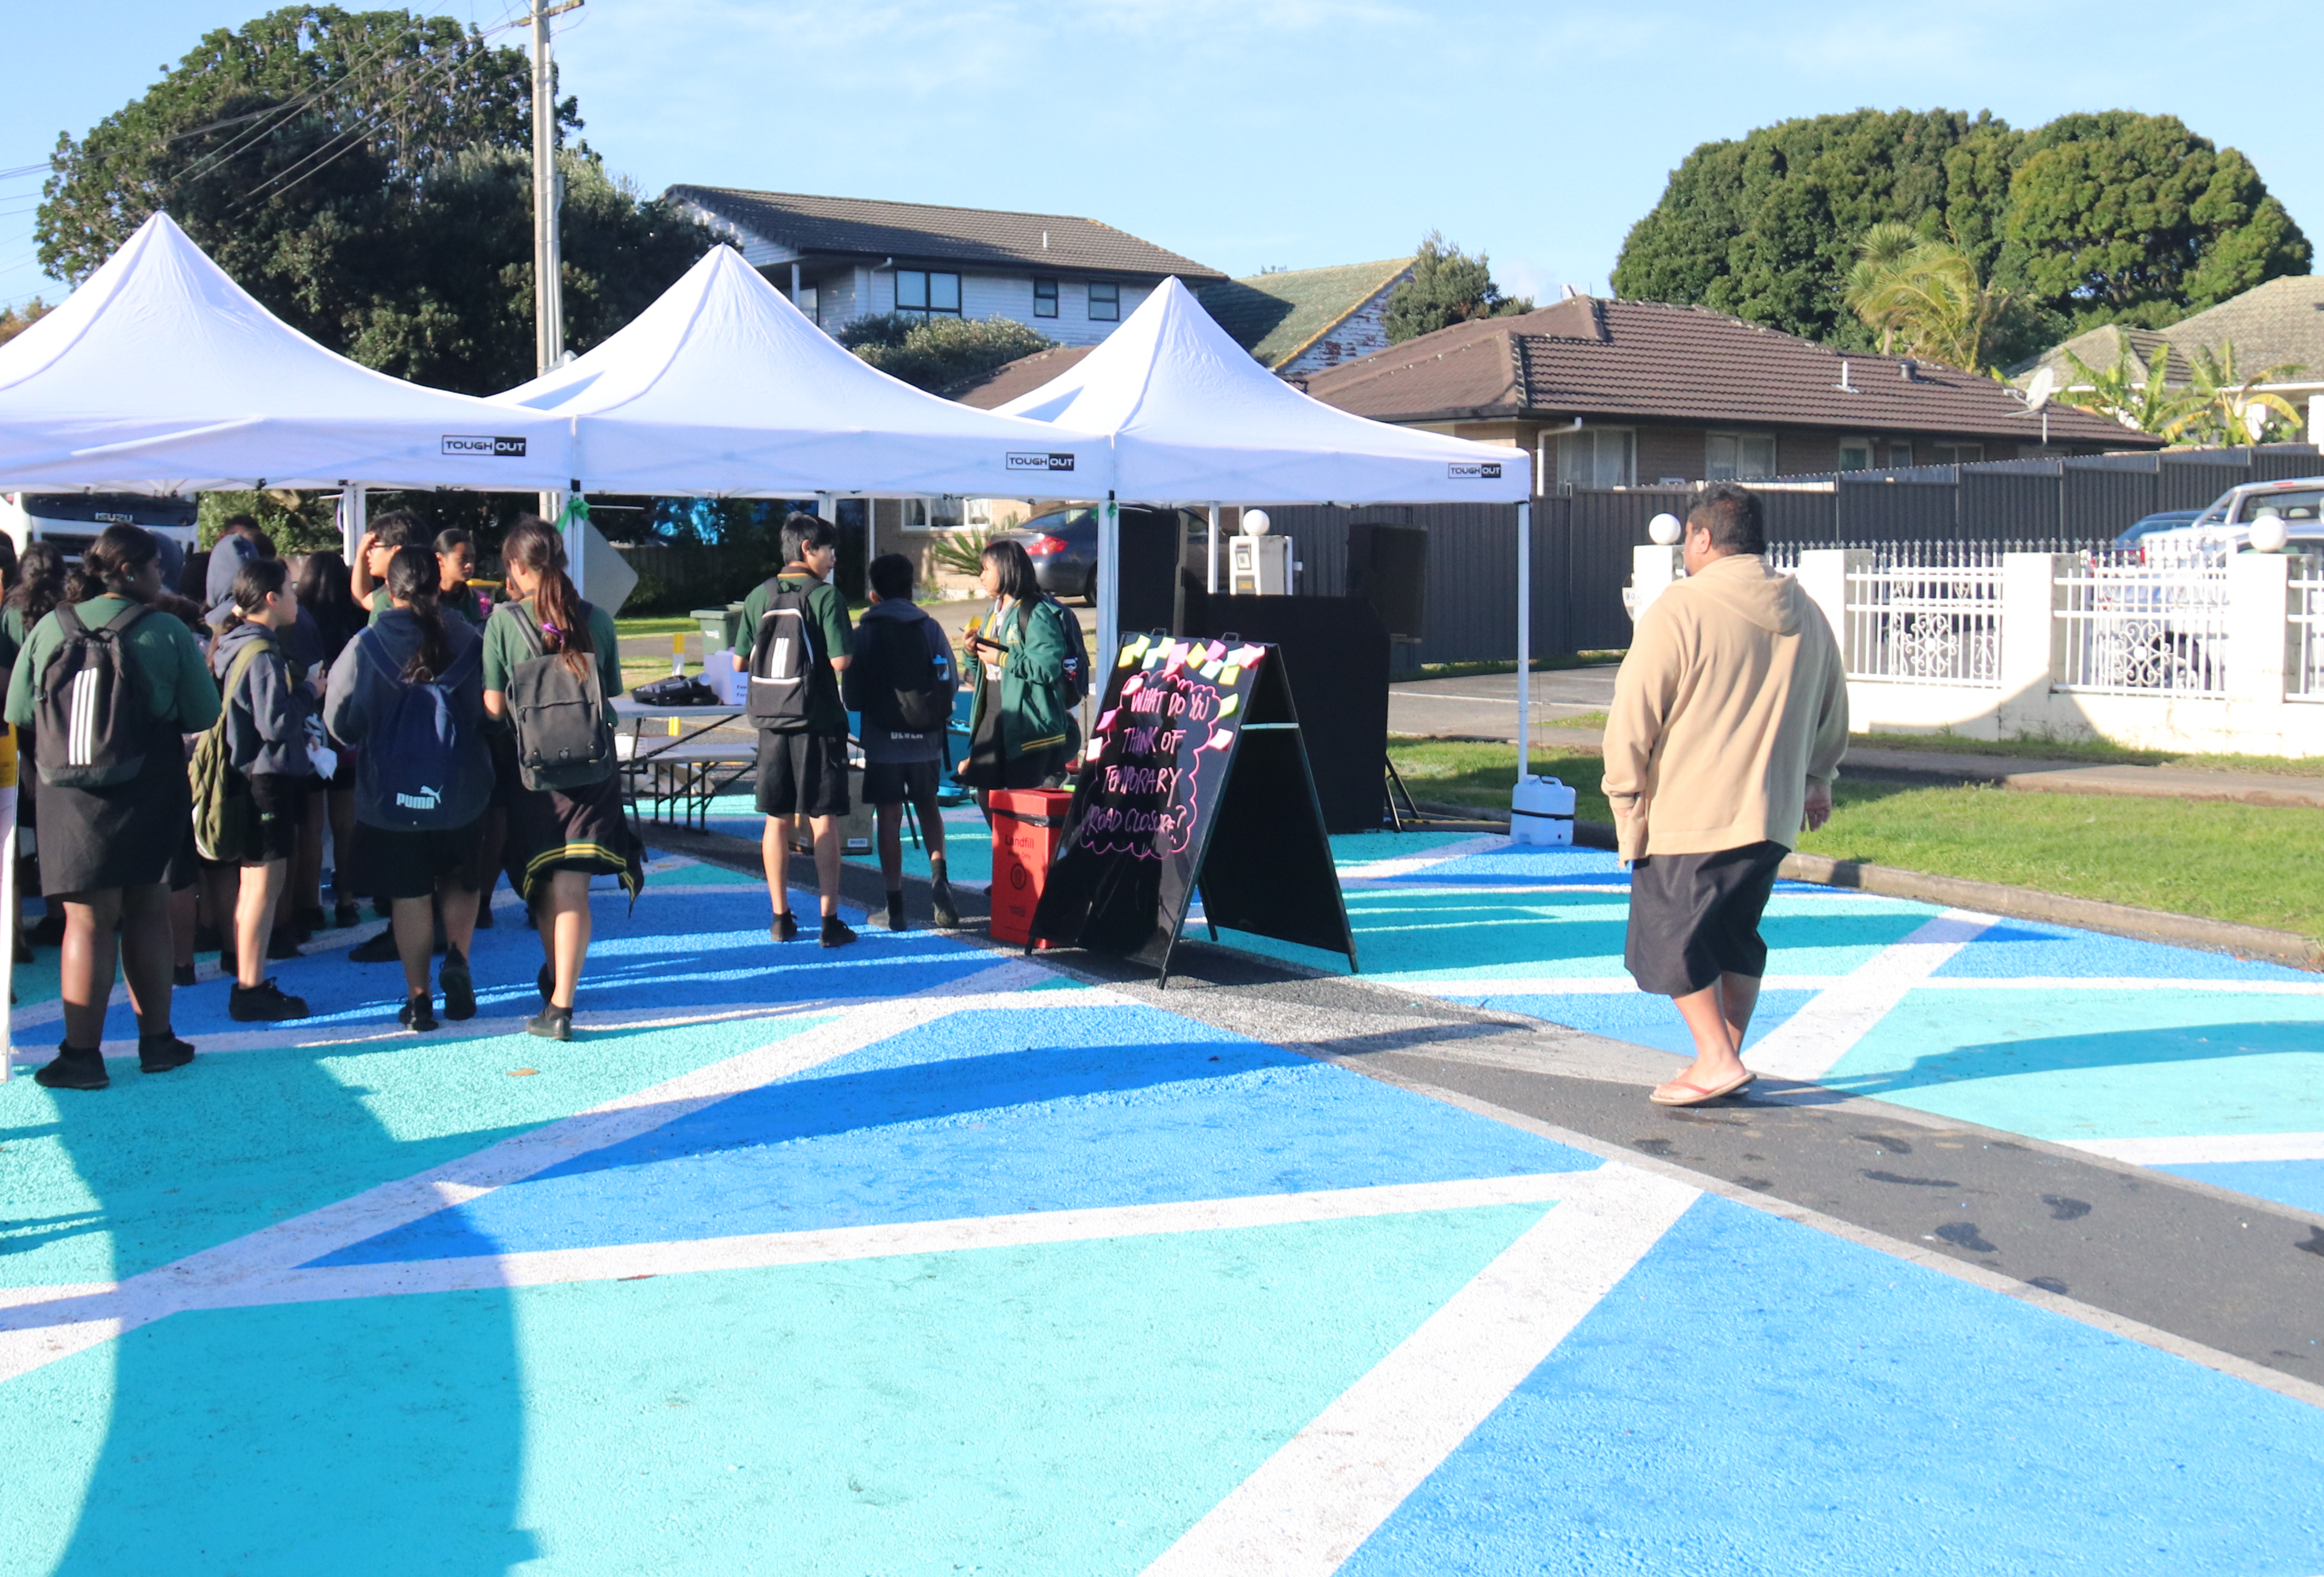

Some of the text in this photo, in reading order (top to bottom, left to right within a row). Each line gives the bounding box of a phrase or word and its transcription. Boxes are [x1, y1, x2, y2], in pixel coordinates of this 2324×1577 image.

[446, 440, 525, 452] TOUGH OUT
[1009, 457, 1073, 467] TOUGH OUT
[1482, 467, 1501, 475] OUT
[95, 512, 134, 523] ISUZU
[1130, 686, 1210, 721] WHAT DO YOU
[1121, 726, 1188, 755] THINK OF
[1101, 764, 1183, 808] TEMPORARY
[396, 792, 435, 809] PUMA
[1086, 803, 1123, 836] ROAD
[1005, 833, 1034, 849] Landfill
